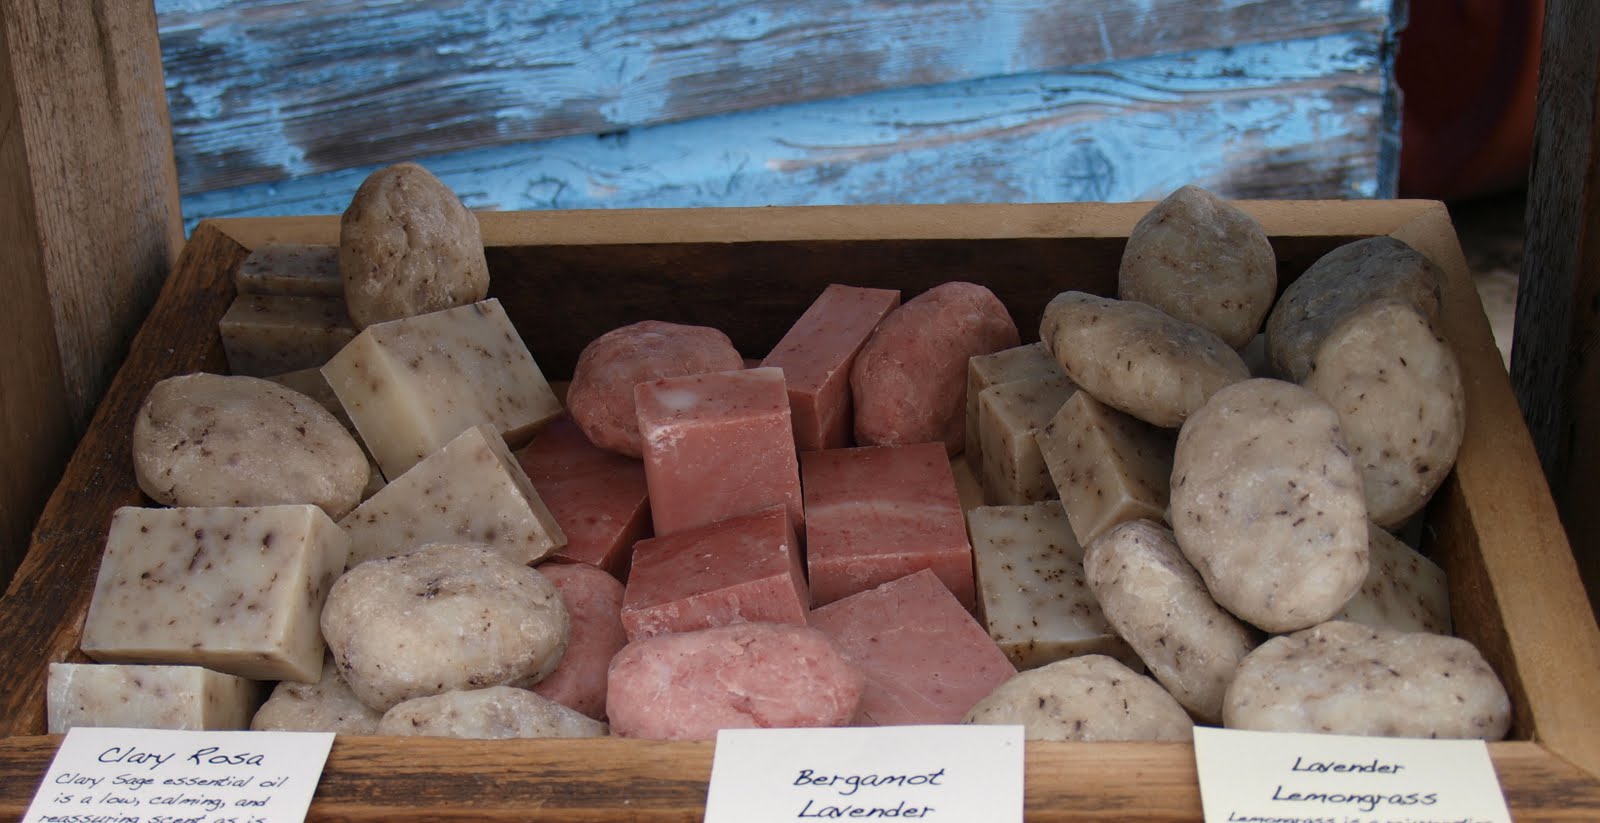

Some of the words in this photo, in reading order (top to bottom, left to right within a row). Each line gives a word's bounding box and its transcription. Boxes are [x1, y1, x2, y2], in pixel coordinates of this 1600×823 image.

[98, 747, 176, 770] Clary
[187, 747, 265, 766] Rosa
[1292, 757, 1405, 774] Lavender
[55, 773, 105, 788] Clary
[112, 773, 155, 791] Sage
[163, 775, 254, 788] essential
[259, 776, 289, 788] oil
[793, 768, 945, 795] Bergamot
[54, 792, 75, 804] is
[80, 796, 93, 804] a
[99, 793, 141, 807] low,
[149, 793, 226, 811] calming,
[235, 796, 271, 807] and
[1272, 785, 1438, 812] Lemongrass
[798, 799, 936, 818] Lavender
